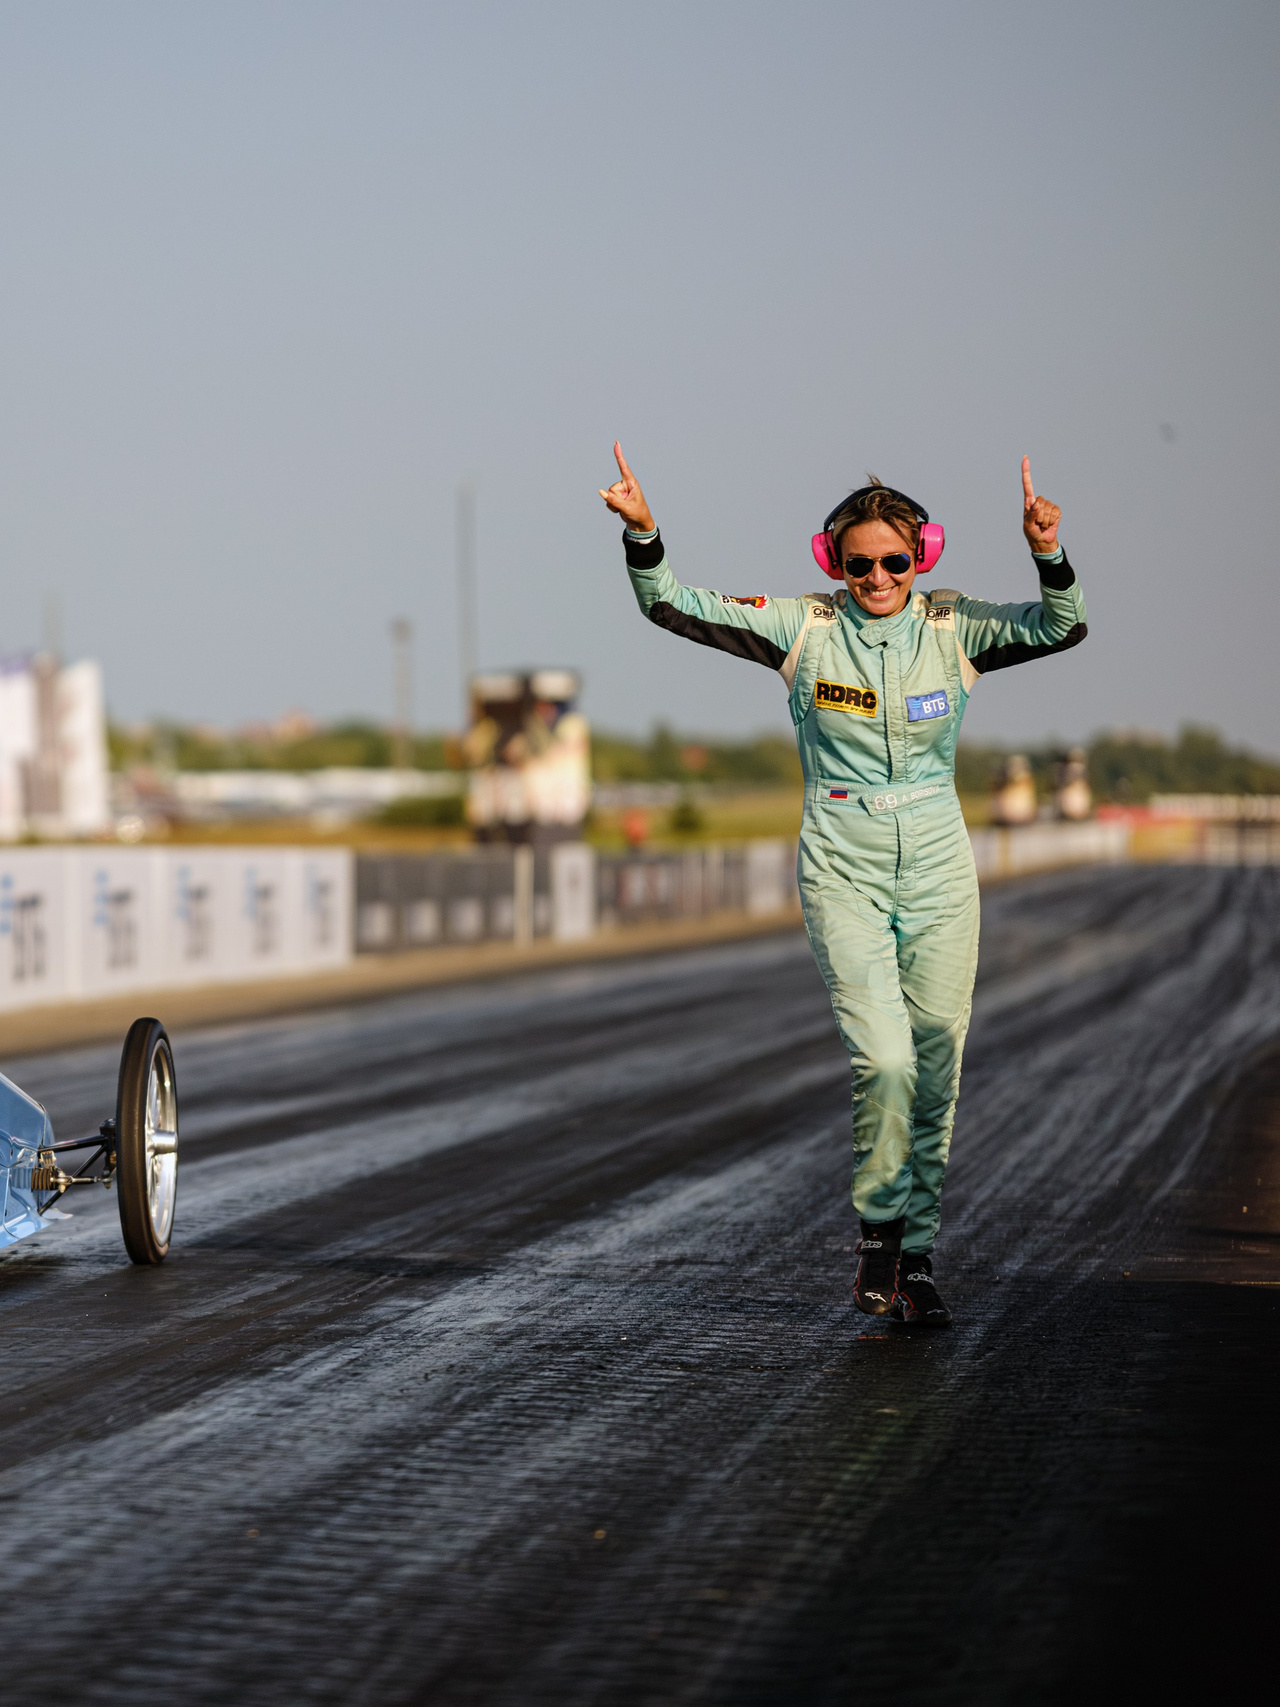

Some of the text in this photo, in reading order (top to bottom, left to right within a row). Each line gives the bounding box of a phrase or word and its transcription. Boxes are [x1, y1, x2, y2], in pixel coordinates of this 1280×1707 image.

[813, 607, 835, 619] OMP
[927, 608, 950, 619] OMP
[922, 697, 946, 714] ВТБ
[874, 794, 898, 810] 69
